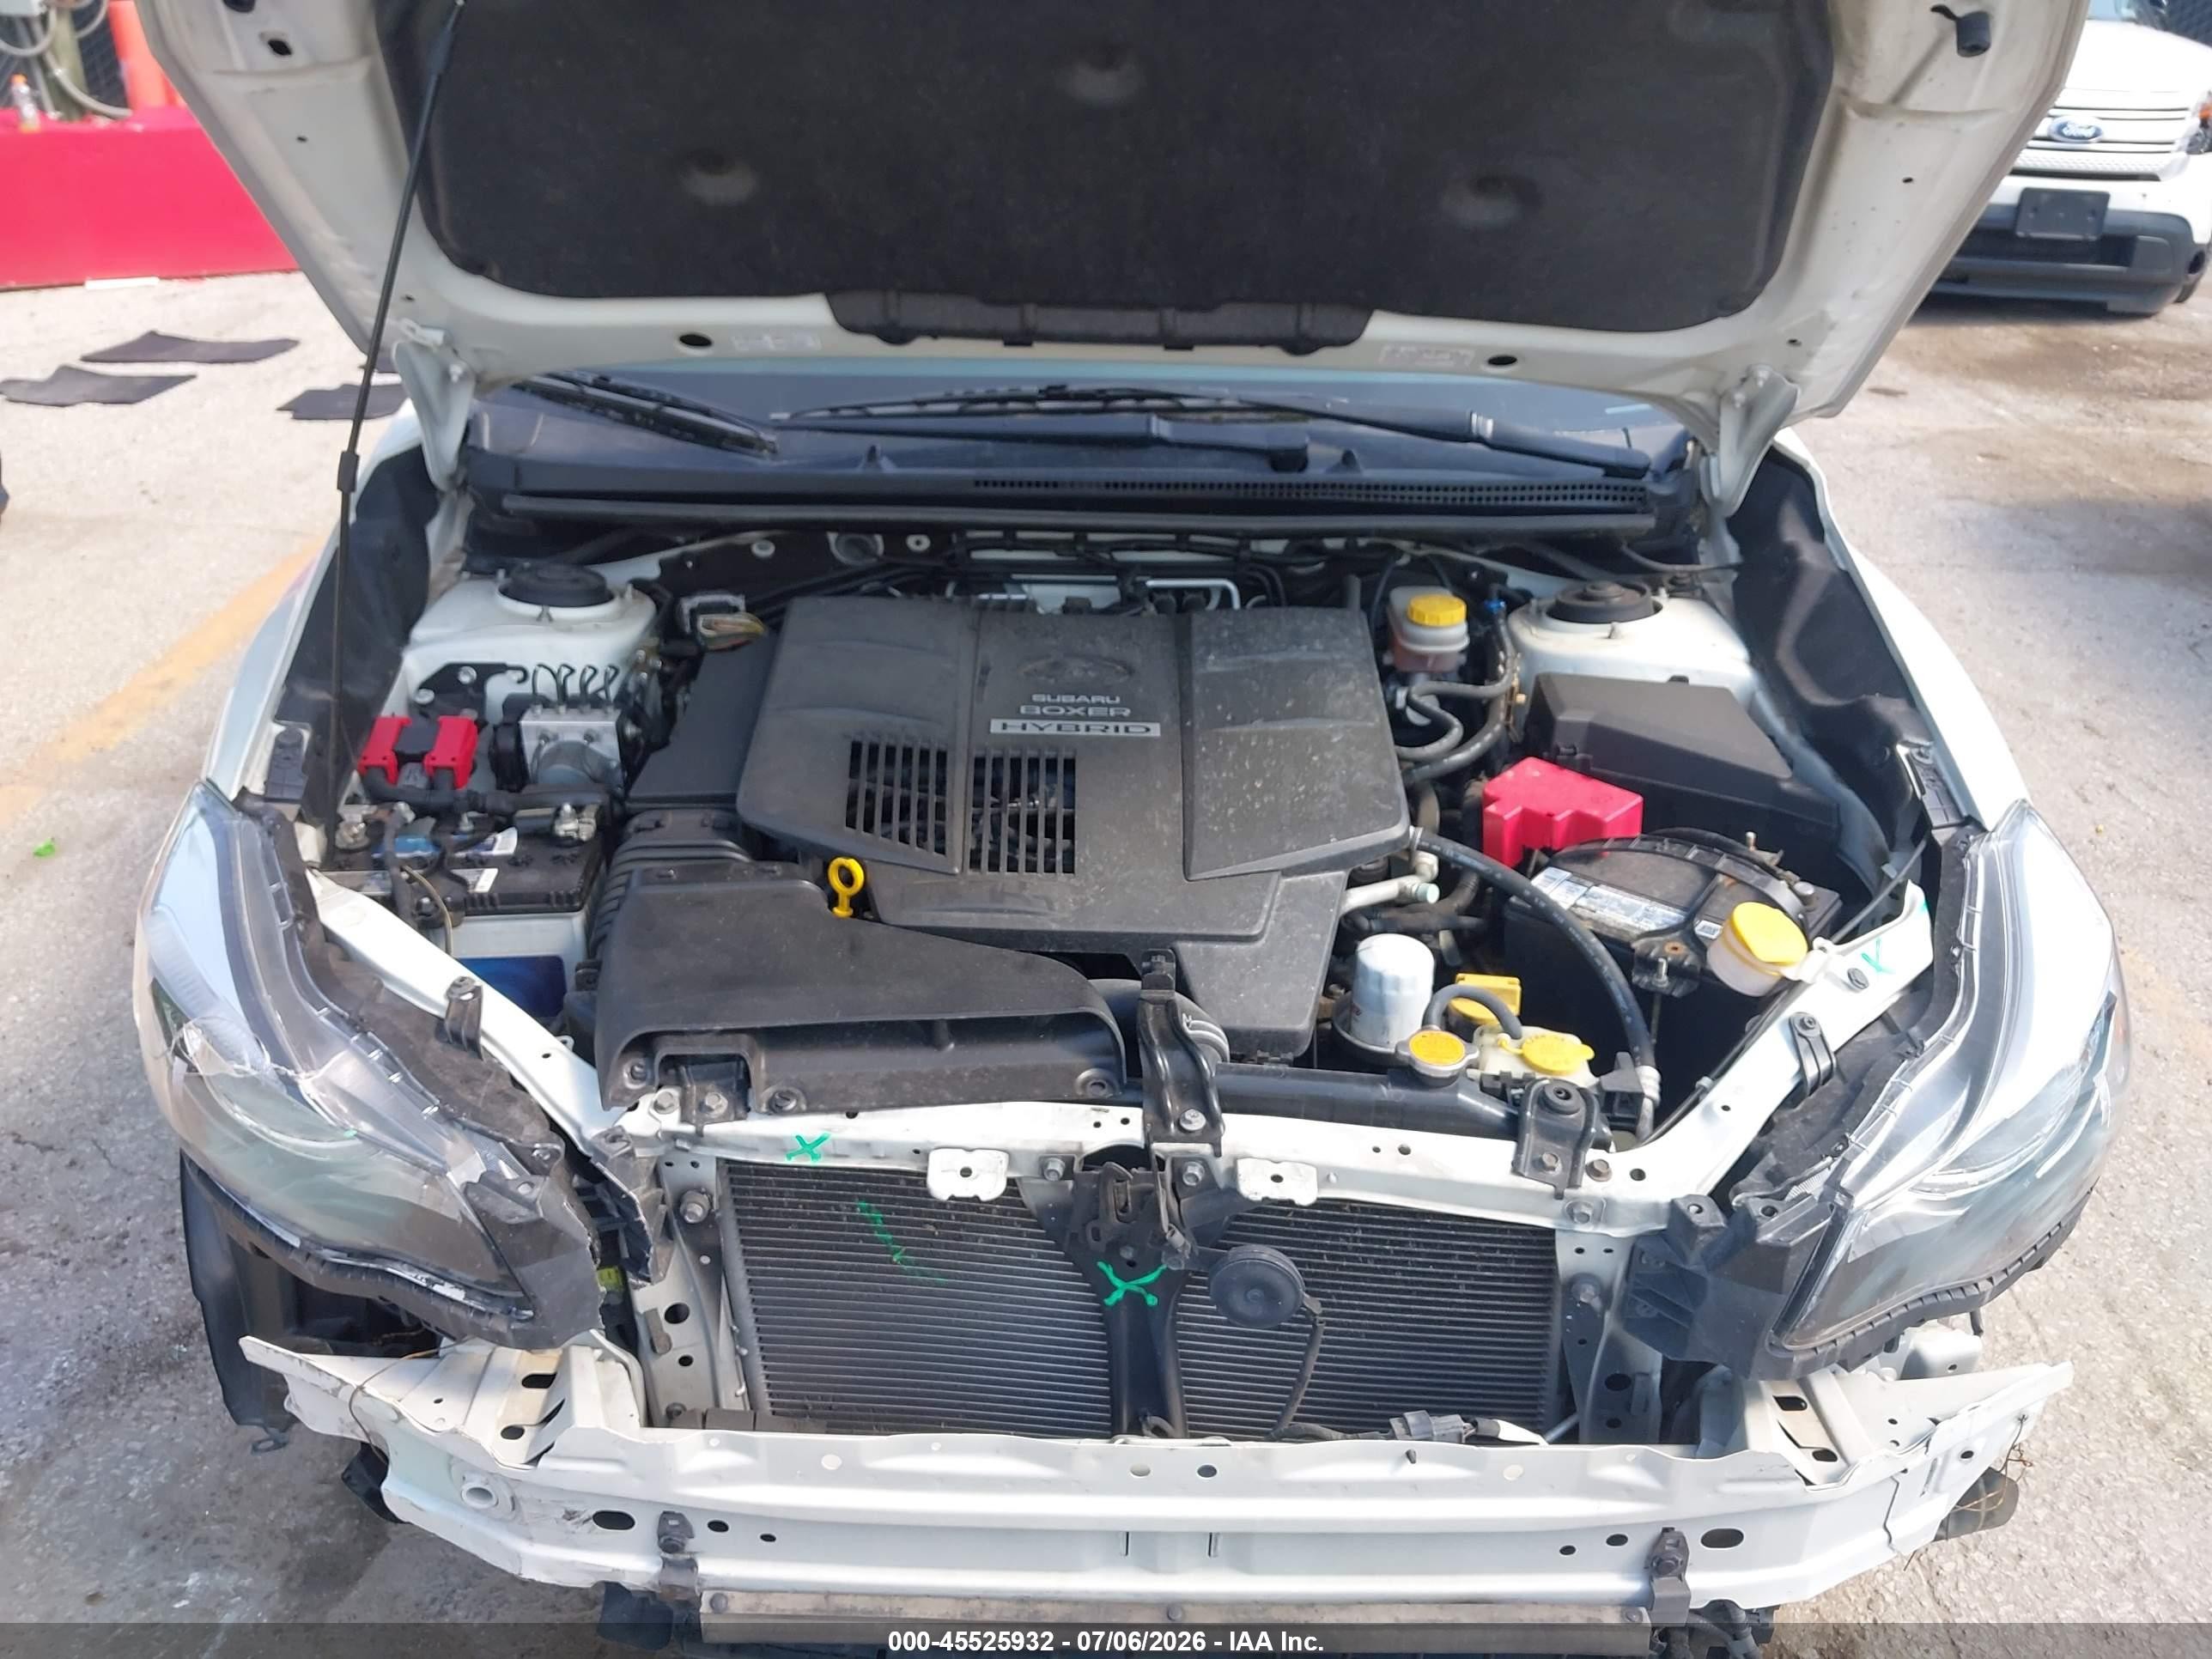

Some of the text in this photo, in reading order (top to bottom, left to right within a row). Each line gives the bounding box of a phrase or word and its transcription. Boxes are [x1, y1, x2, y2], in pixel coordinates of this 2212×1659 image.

[1031, 693, 1121, 704] SUBARU
[1019, 704, 1132, 717] BOXER
[1001, 721, 1152, 734] HYBRID
